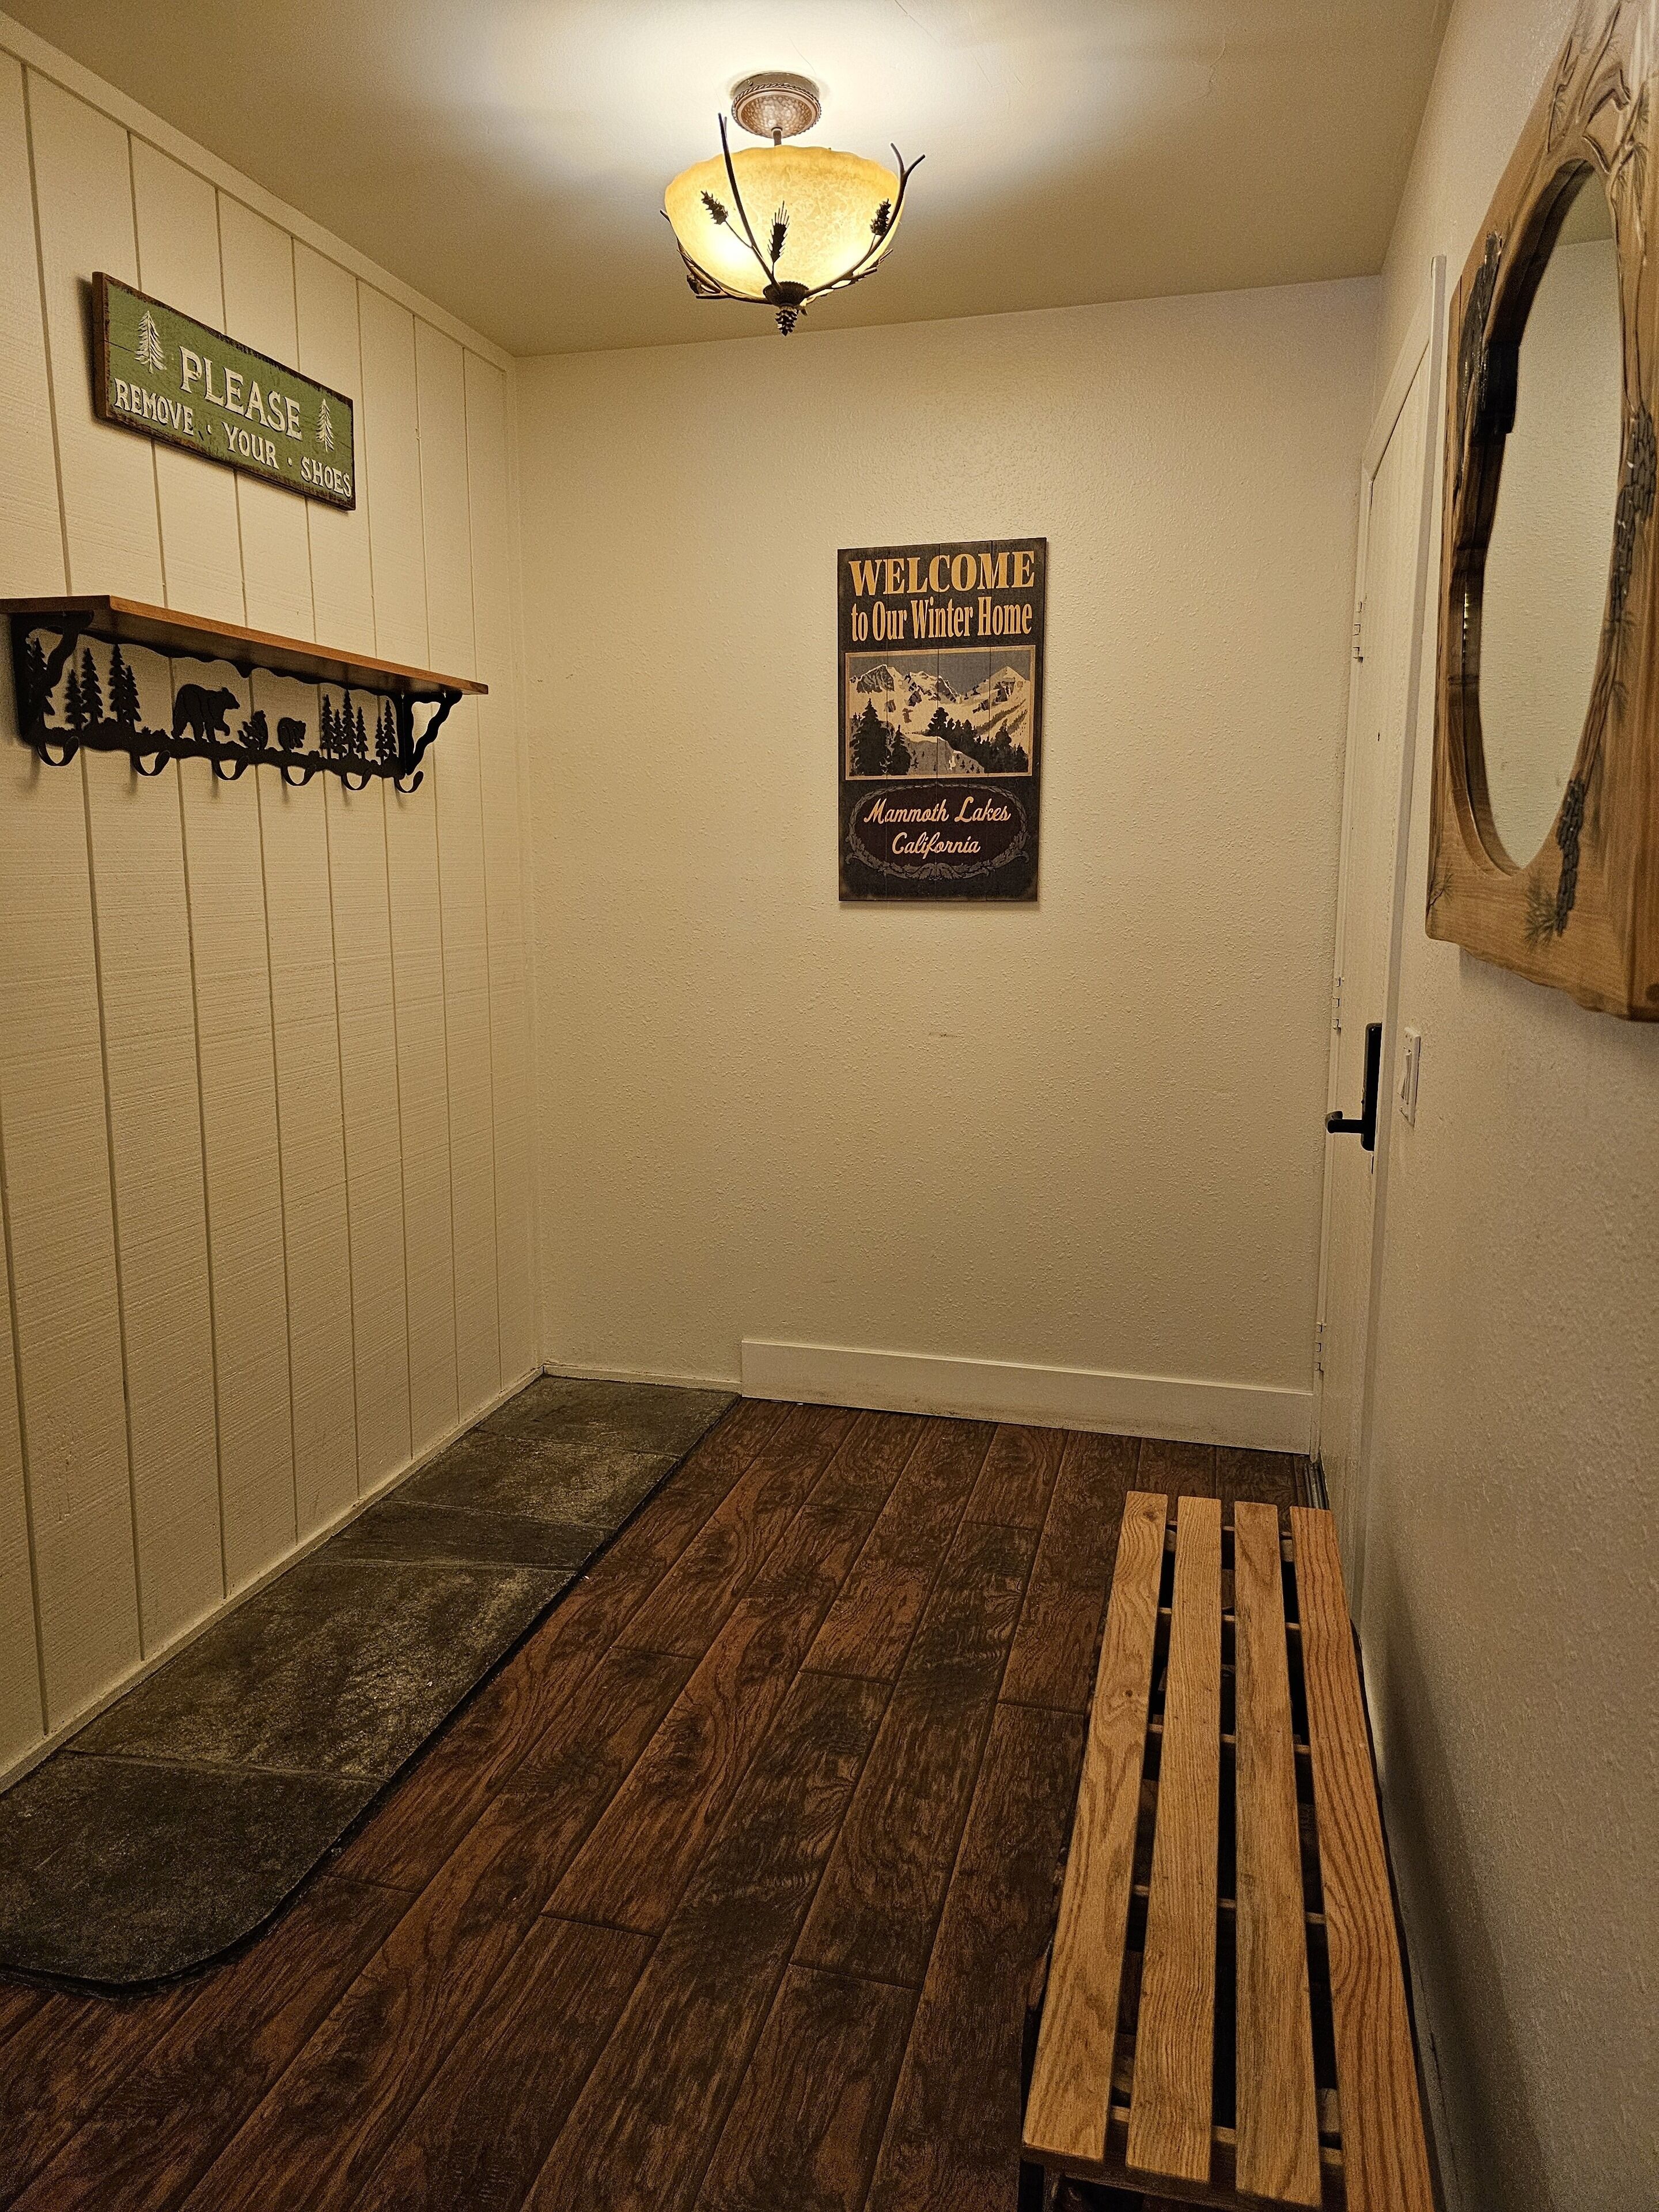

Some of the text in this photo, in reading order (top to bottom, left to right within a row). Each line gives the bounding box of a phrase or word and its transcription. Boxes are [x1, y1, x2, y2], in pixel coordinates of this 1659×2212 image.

[179, 346, 302, 441] PLEASE
[114, 378, 352, 498] REMOVE YOUR SHOES
[849, 551, 1035, 596] WELCOME
[851, 596, 1033, 642] to Our Winter Home
[863, 796, 1012, 824] Mammoth Lakes
[892, 832, 981, 859] California
